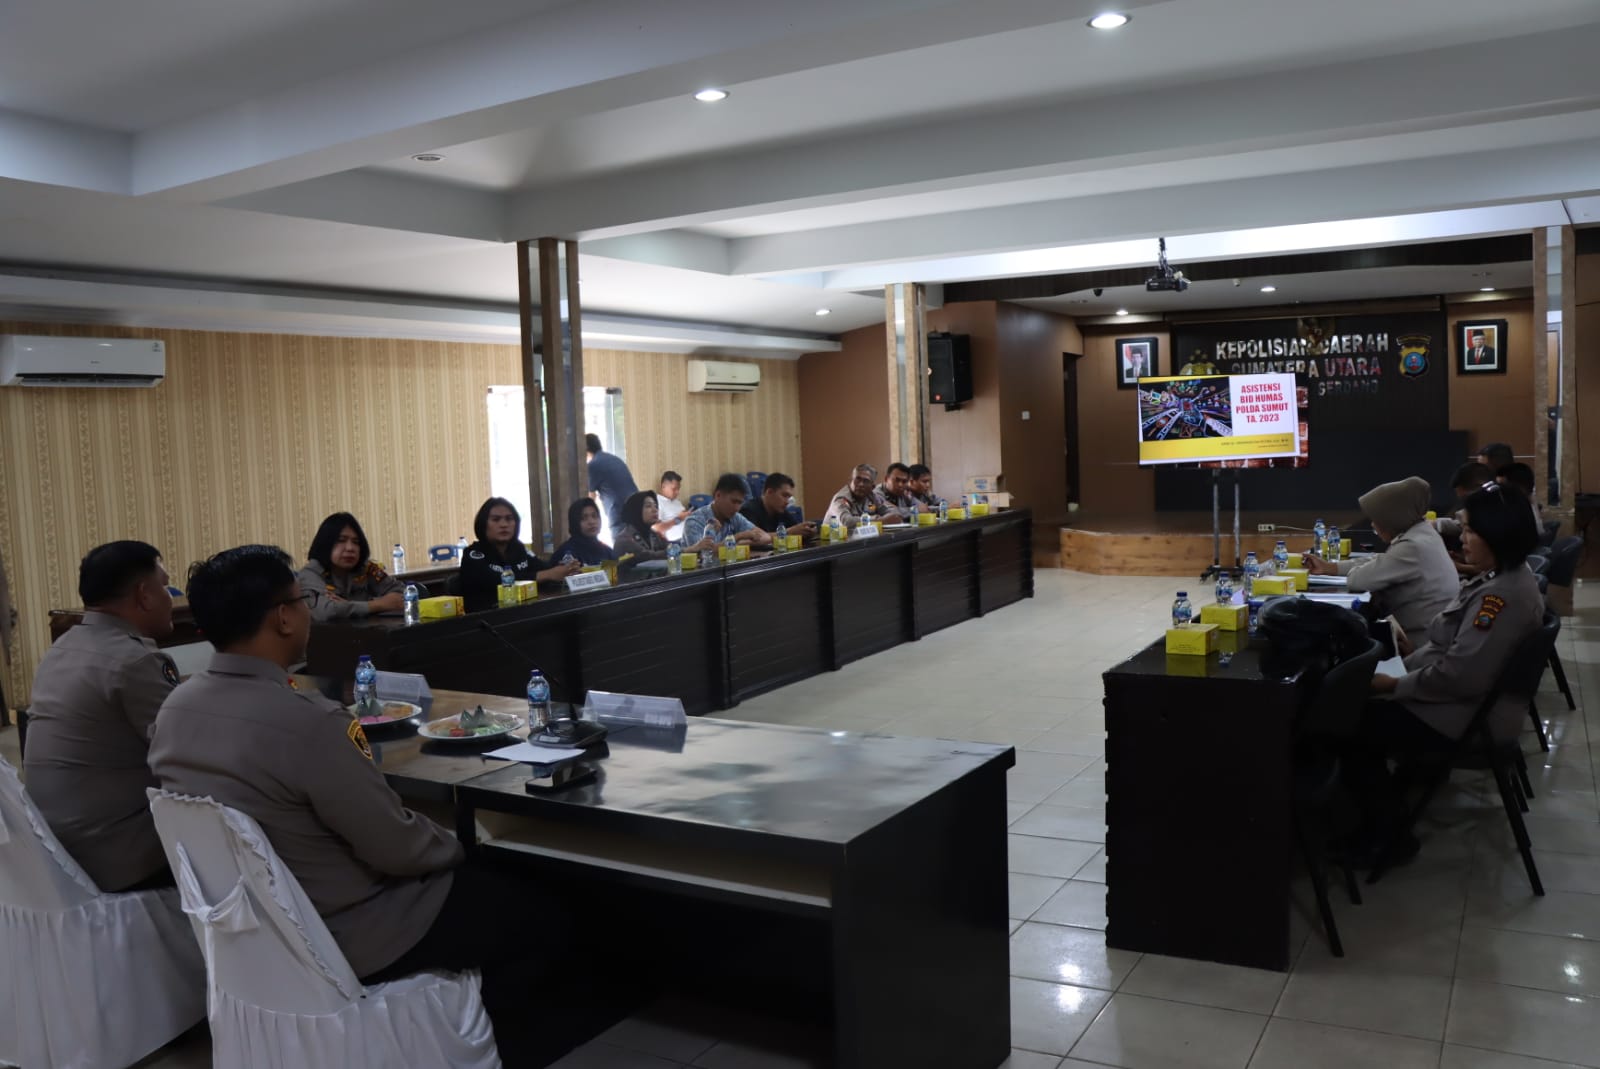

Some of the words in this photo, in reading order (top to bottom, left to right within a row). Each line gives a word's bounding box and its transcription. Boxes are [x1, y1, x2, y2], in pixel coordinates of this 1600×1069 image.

[1324, 356, 1382, 377] UTARA
[1241, 383, 1281, 393] ASISTENSI
[1240, 395, 1254, 404] BID
[1255, 393, 1284, 403] HUMAS
[1236, 404, 1260, 414] POLDA
[1261, 403, 1289, 413] SUMUT
[1259, 413, 1280, 423] 2023
